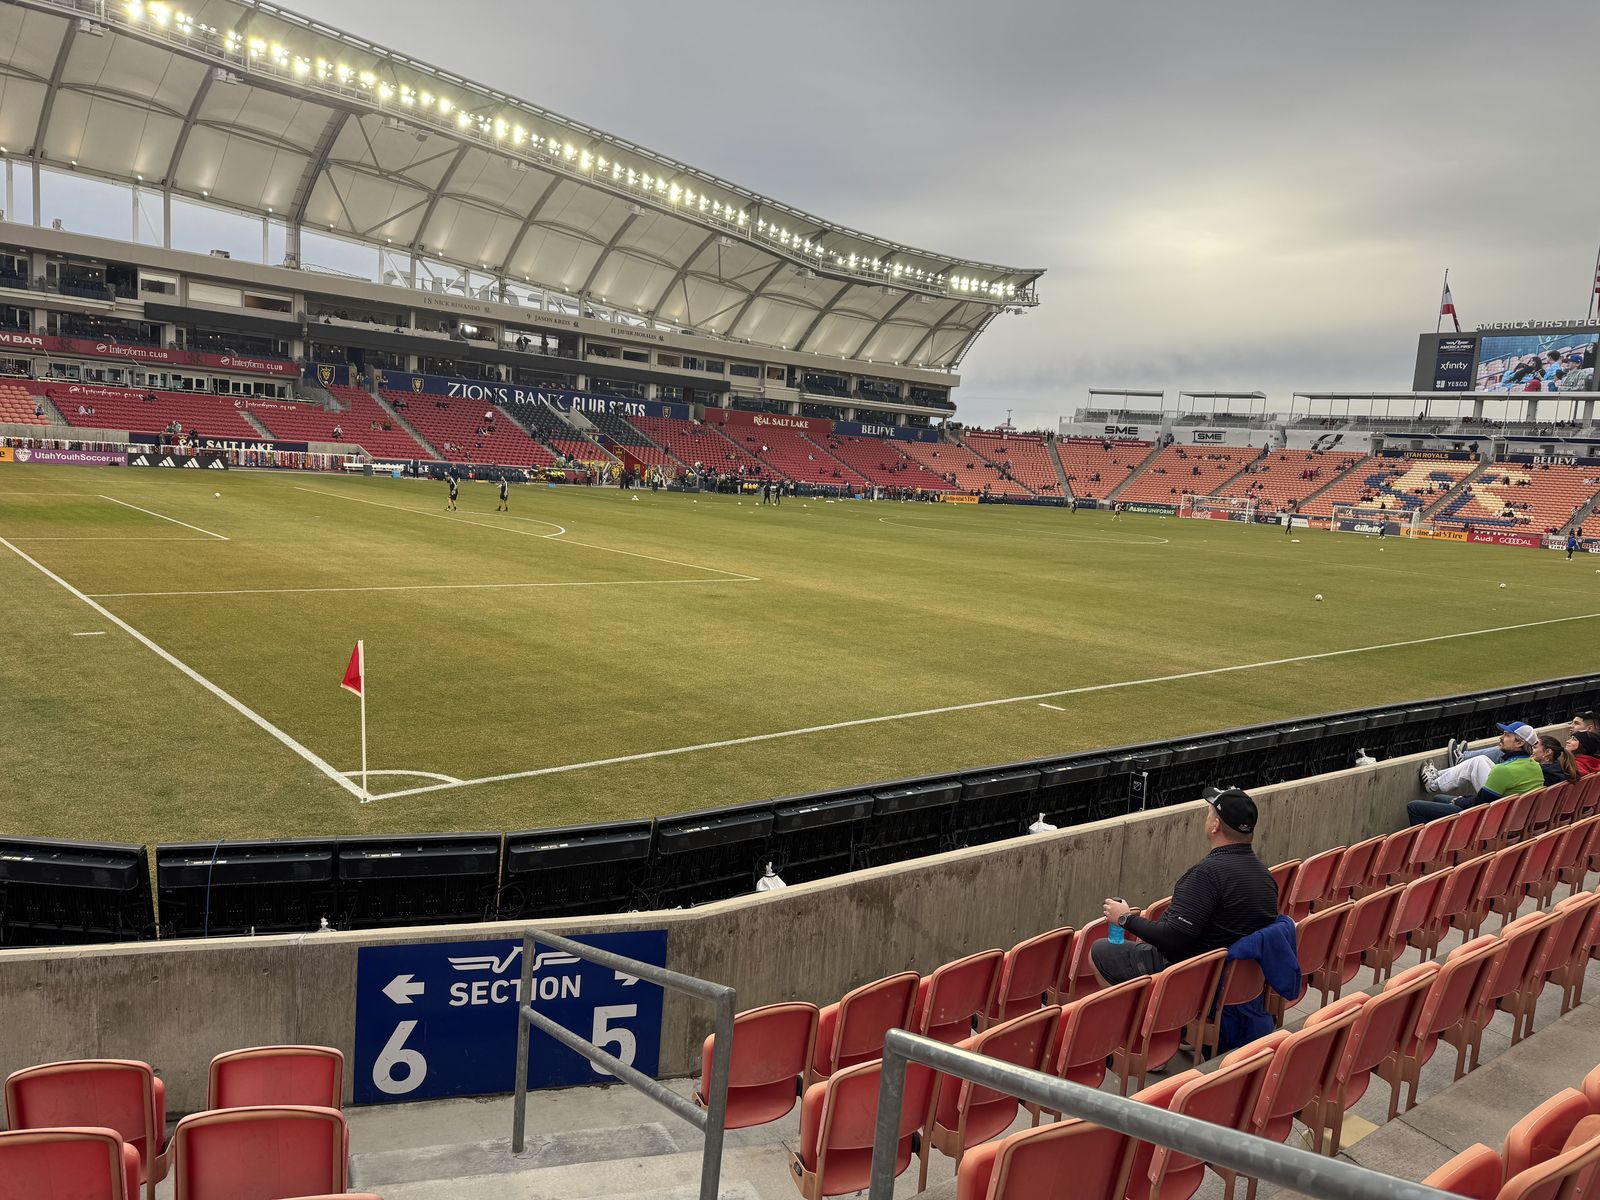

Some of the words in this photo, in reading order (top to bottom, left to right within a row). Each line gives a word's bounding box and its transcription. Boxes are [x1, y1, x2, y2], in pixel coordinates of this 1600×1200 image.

[534, 315, 553, 323] JASON
[1476, 320, 1530, 330] AMERICA
[1533, 319, 1570, 328] FIRST
[13, 336, 42, 346] BAR
[634, 331, 656, 340] MORALES
[109, 345, 147, 357] Interform
[232, 357, 265, 369] Interform
[1440, 361, 1468, 370] xfinity
[447, 381, 508, 403] ZIONS
[772, 417, 790, 427] SALT
[790, 419, 809, 429] LAKE
[861, 424, 896, 437] BELIEVE
[1104, 425, 1139, 435] SME
[34, 451, 125, 463] UtahYouthSoccer.net
[1533, 456, 1578, 466] BELIEVE
[1148, 507, 1175, 515] UNIFORMS
[1446, 531, 1463, 539] Tire
[448, 974, 582, 1007] SECTION
[372, 1019, 428, 1095] 6
[589, 1003, 638, 1076] 5
